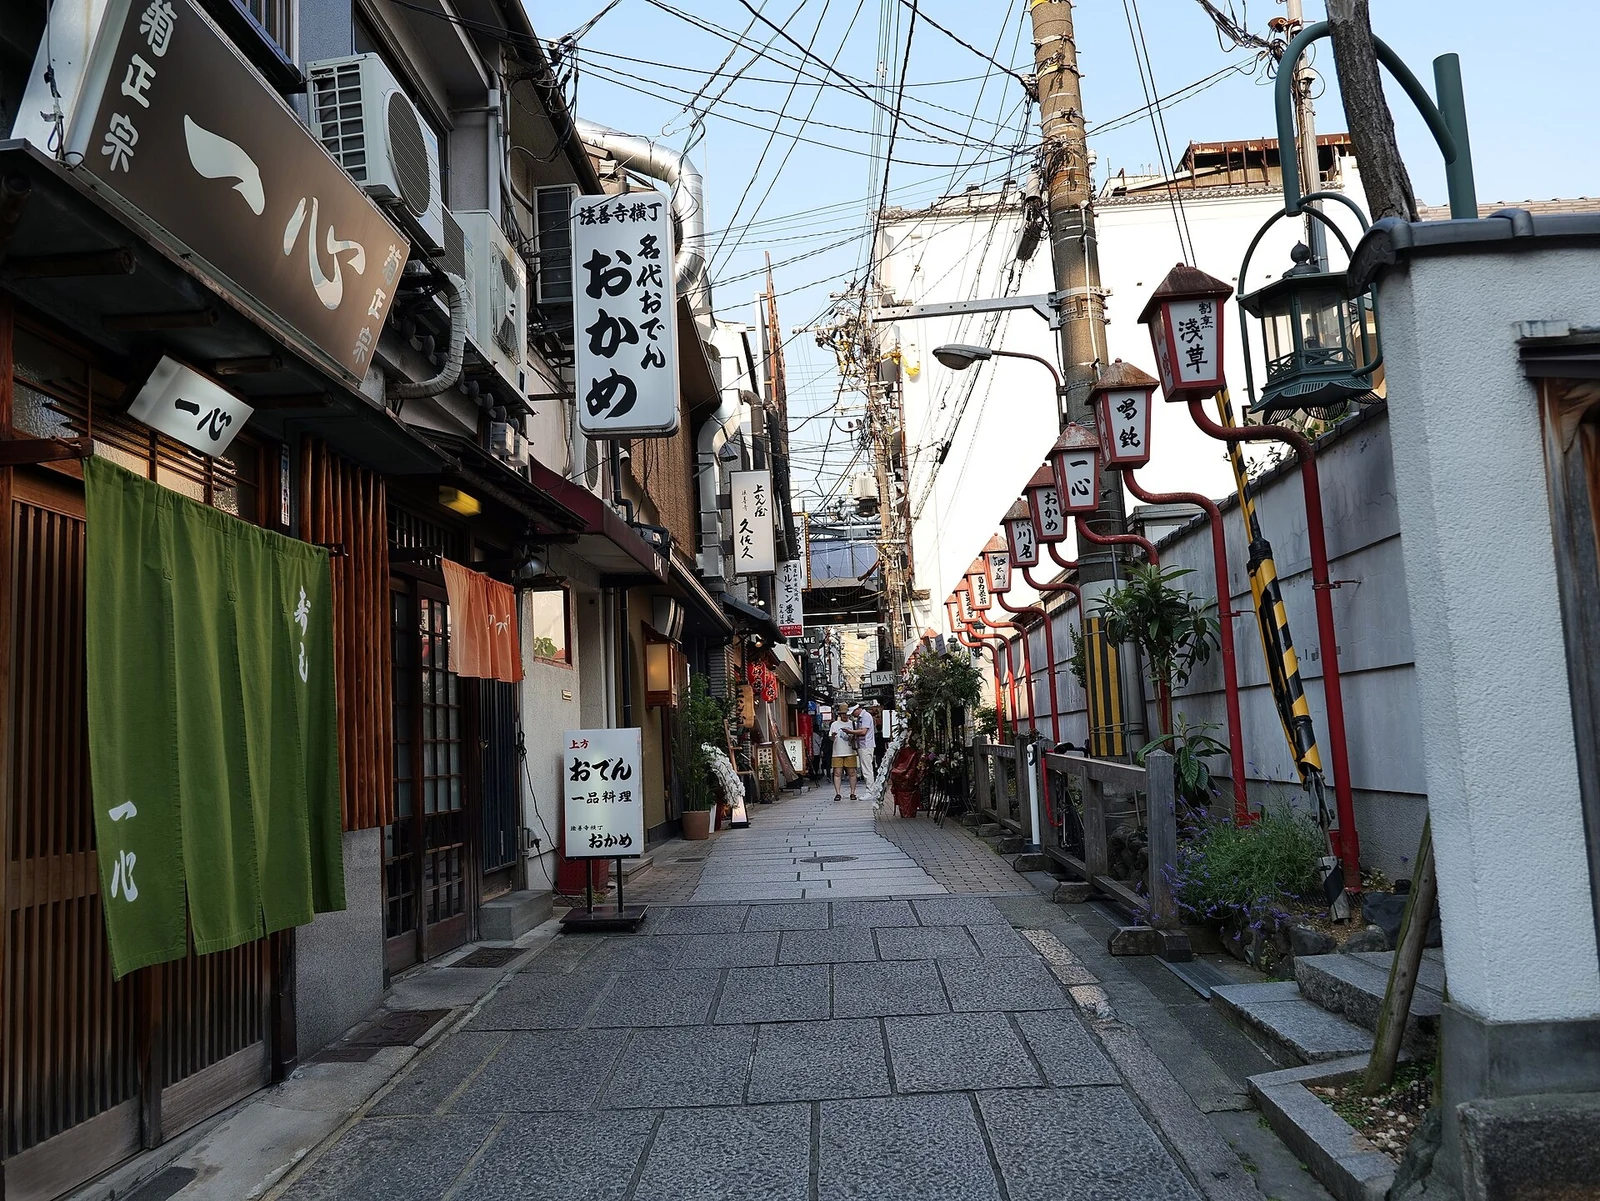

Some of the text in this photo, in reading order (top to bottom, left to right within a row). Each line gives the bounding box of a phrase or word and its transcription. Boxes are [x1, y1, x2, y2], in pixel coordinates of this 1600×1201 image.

[101, 0, 179, 173] 菊正宗
[183, 113, 367, 311] 一心
[579, 202, 663, 226] 法善寺横丁
[352, 243, 403, 364] 菊正宗
[636, 233, 666, 370] 名代おでん
[1198, 301, 1214, 329] 割烹
[582, 248, 640, 420] おかめ
[174, 397, 232, 442] 一心
[1069, 459, 1091, 497] 一心
[1044, 491, 1059, 532] おかめ
[1016, 528, 1033, 559] 川名
[782, 563, 795, 625] ホルモン番長
[569, 739, 589, 749] 上方
[568, 757, 632, 782] おでん
[571, 789, 633, 805] 一品料理
[108, 800, 138, 903] 一心
[588, 832, 633, 849] おかめ
